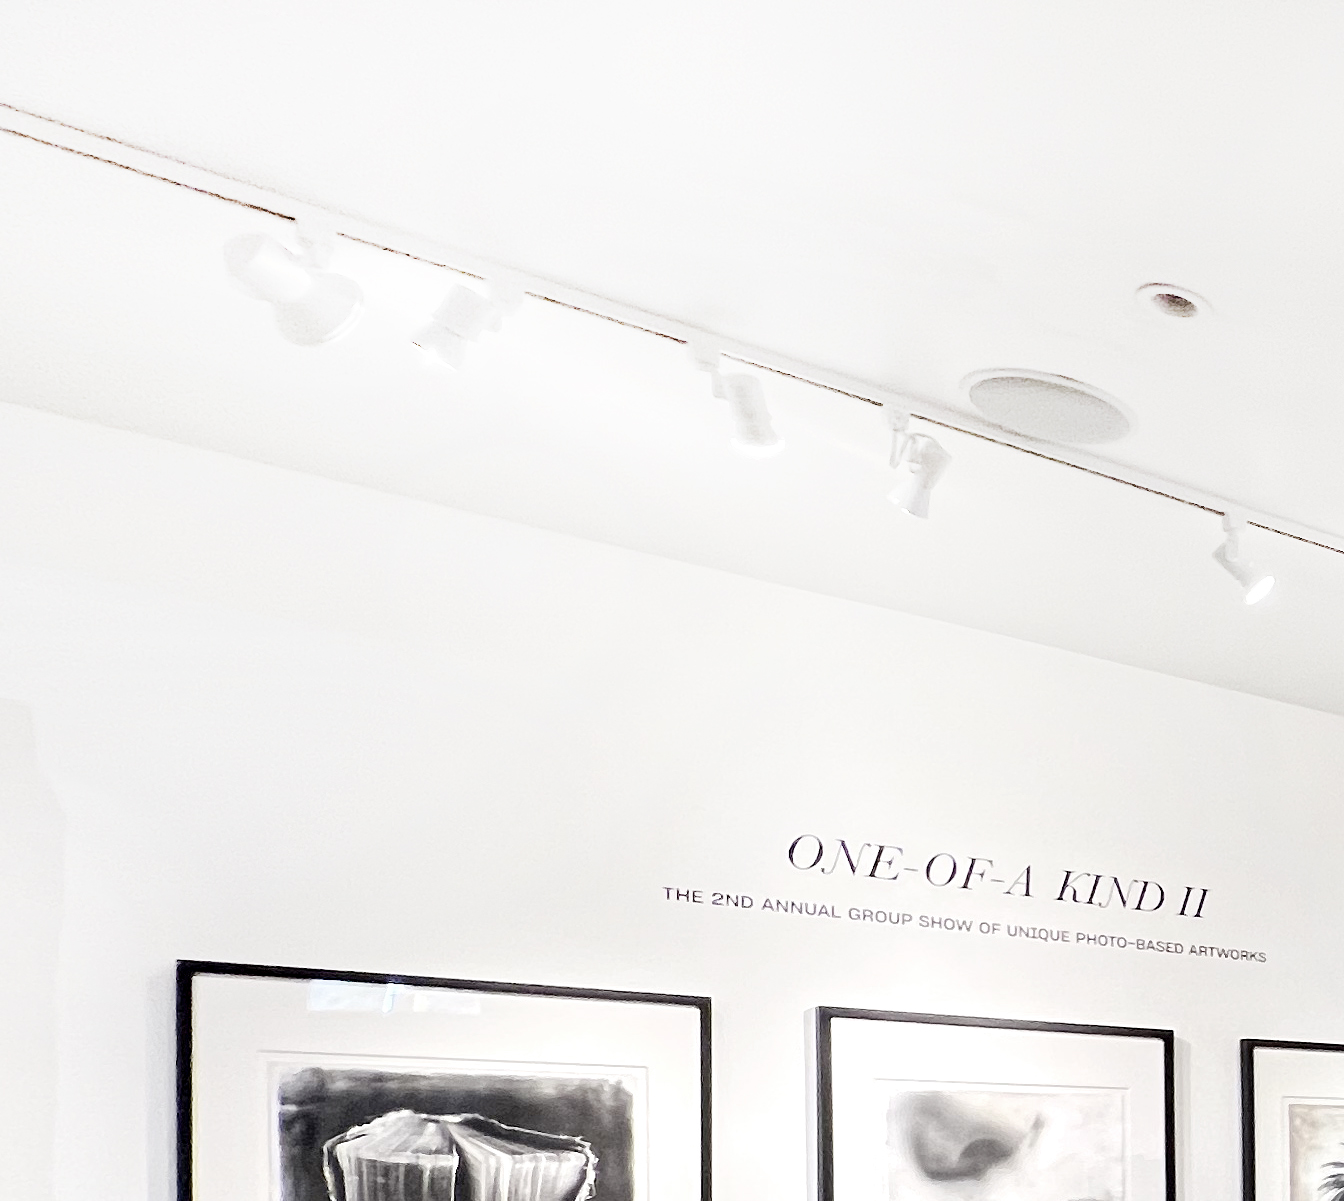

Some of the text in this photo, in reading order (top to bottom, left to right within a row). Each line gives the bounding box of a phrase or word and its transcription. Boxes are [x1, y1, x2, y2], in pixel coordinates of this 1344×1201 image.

[787, 833, 1212, 918] ONE-OF-A KIND II
[662, 886, 1268, 963] THE 2ND ANNUAL GROUP SHOW OF UNIQUE PHOTO-BASED ARTWORKS
